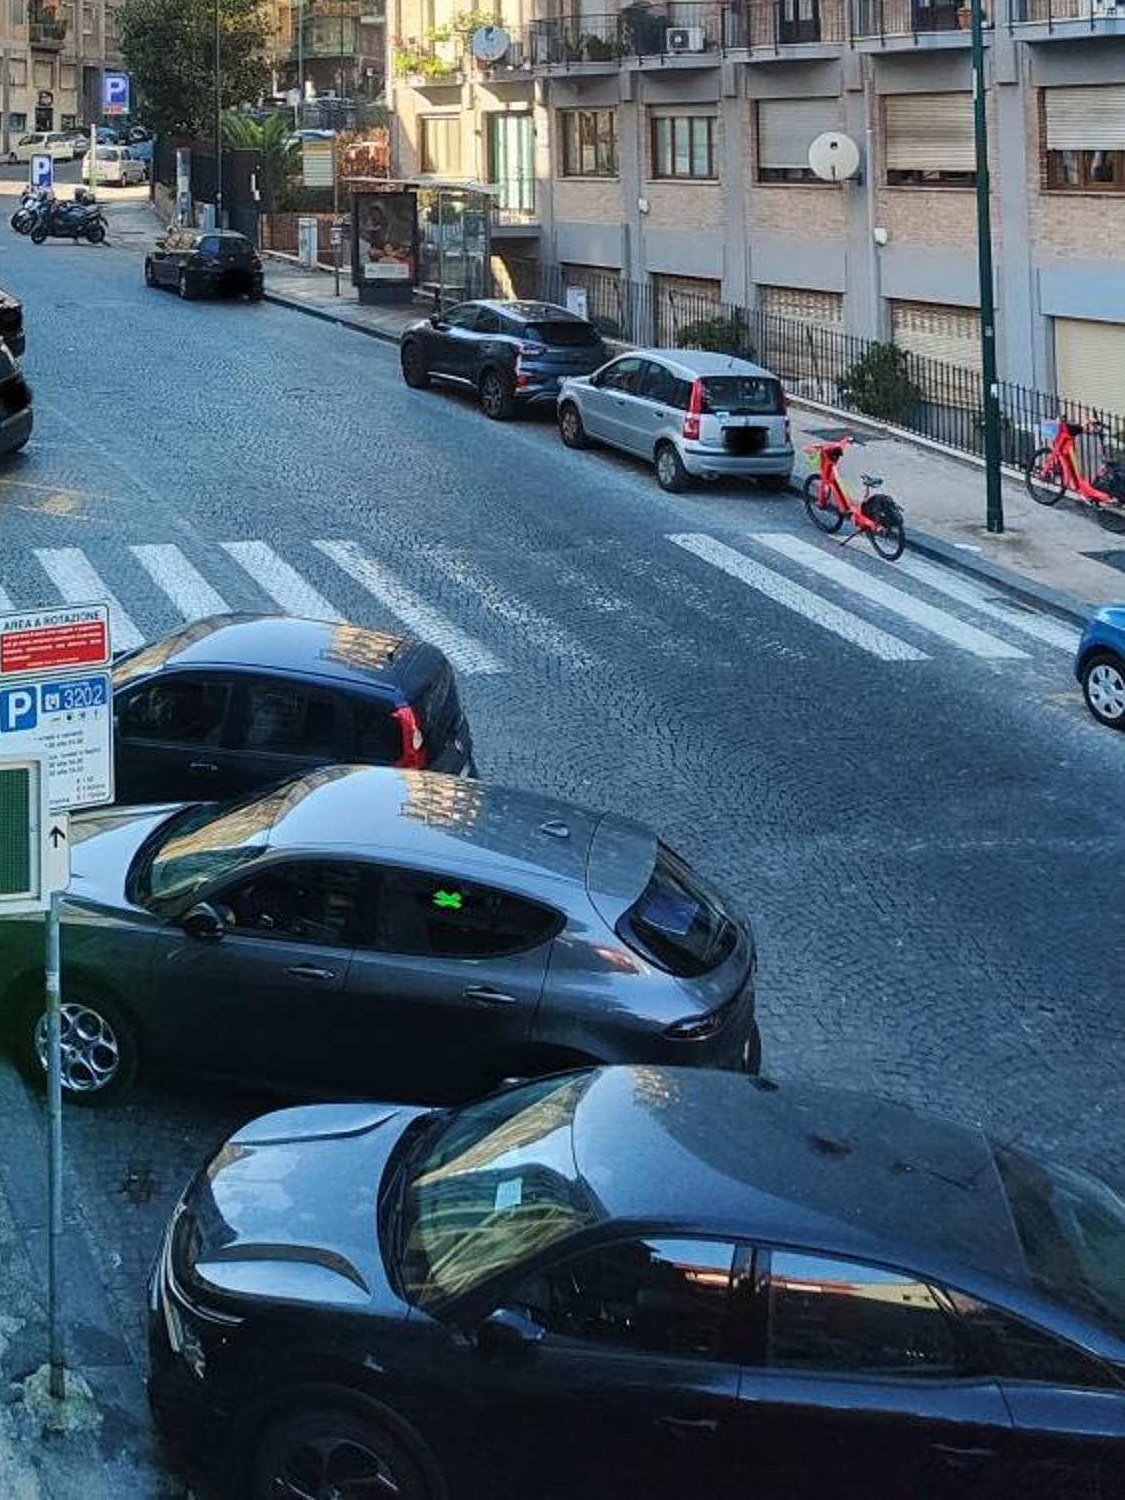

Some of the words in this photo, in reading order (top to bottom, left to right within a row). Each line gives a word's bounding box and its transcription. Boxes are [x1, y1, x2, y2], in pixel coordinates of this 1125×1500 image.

[105, 77, 125, 103] P
[32, 155, 51, 185] P
[4, 618, 32, 631] AREA
[44, 609, 101, 625] ROTAZIONE
[63, 684, 104, 708] 3202
[8, 691, 32, 728] P
